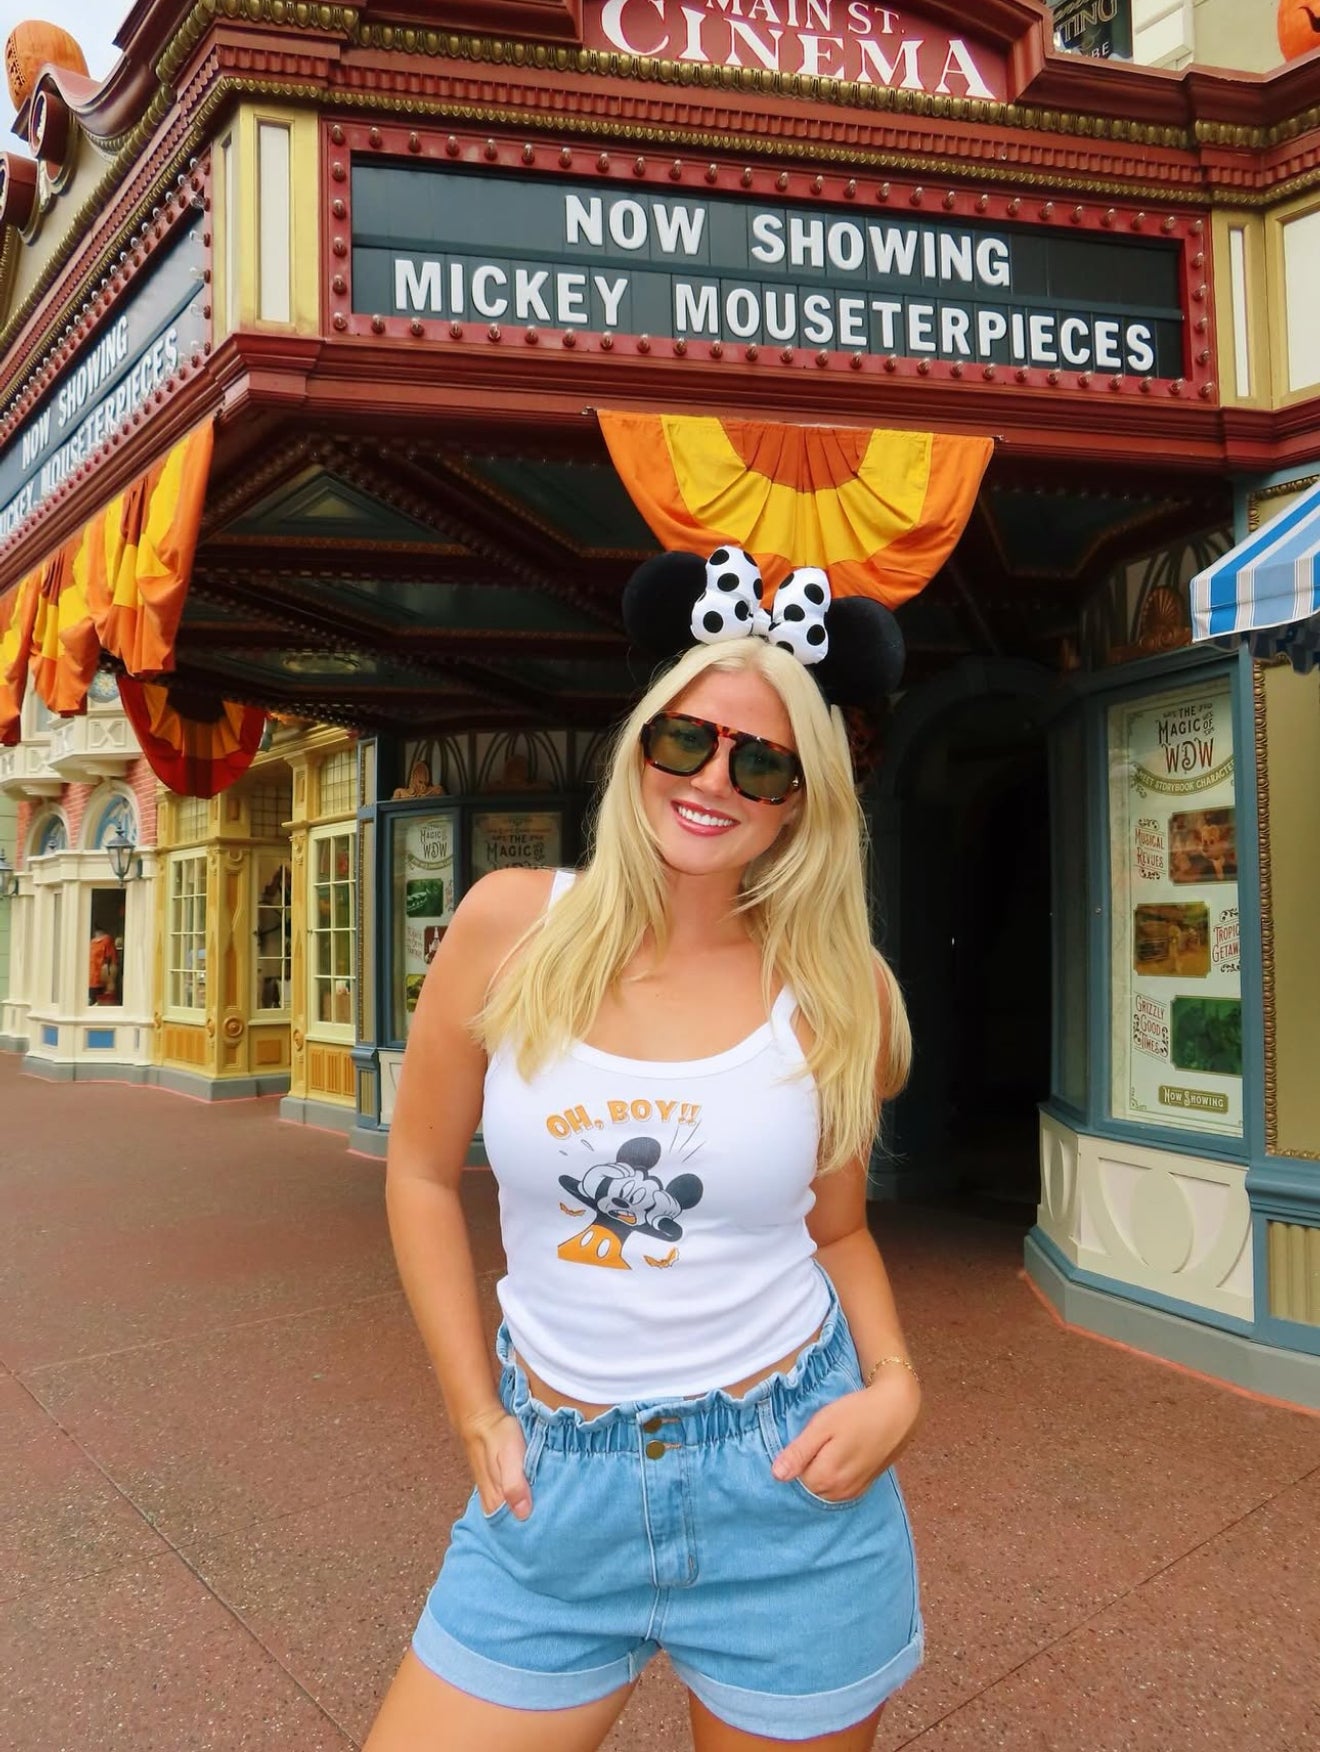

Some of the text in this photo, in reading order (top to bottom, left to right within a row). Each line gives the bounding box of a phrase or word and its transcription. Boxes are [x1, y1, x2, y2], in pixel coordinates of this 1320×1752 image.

[848, 2, 905, 35] ST.
[601, 0, 997, 100] CINEMA
[564, 194, 1011, 288] NOW SHOWING
[394, 259, 1155, 371] MICKEY MOUSETERPIECES
[22, 315, 129, 469] NOW SHOWING
[0, 480, 34, 541] ICKEY
[1157, 718, 1200, 746] MAGIC
[1180, 706, 1195, 718] THE
[546, 1098, 702, 1140] OH, BOY!!
[1162, 1086, 1224, 1108] NOW SHOWING
